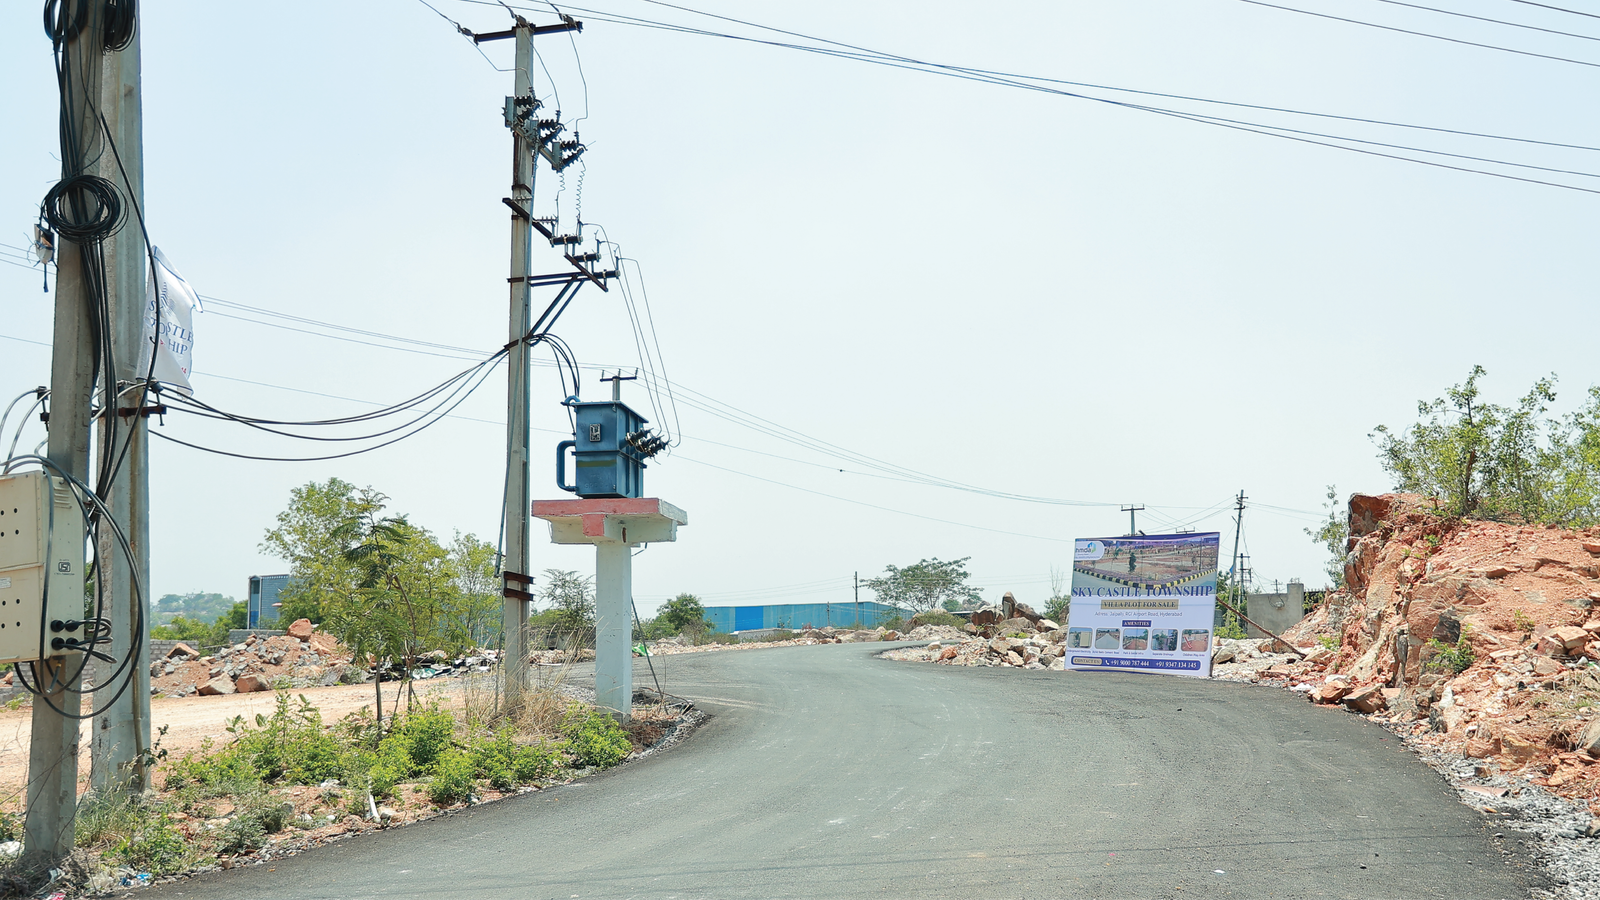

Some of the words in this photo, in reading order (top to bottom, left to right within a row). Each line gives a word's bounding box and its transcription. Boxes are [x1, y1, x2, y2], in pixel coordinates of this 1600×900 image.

[1071, 587, 1096, 597] SKY
[1097, 586, 1141, 597] CASTLE
[1145, 585, 1214, 597] TOWNSHIP
